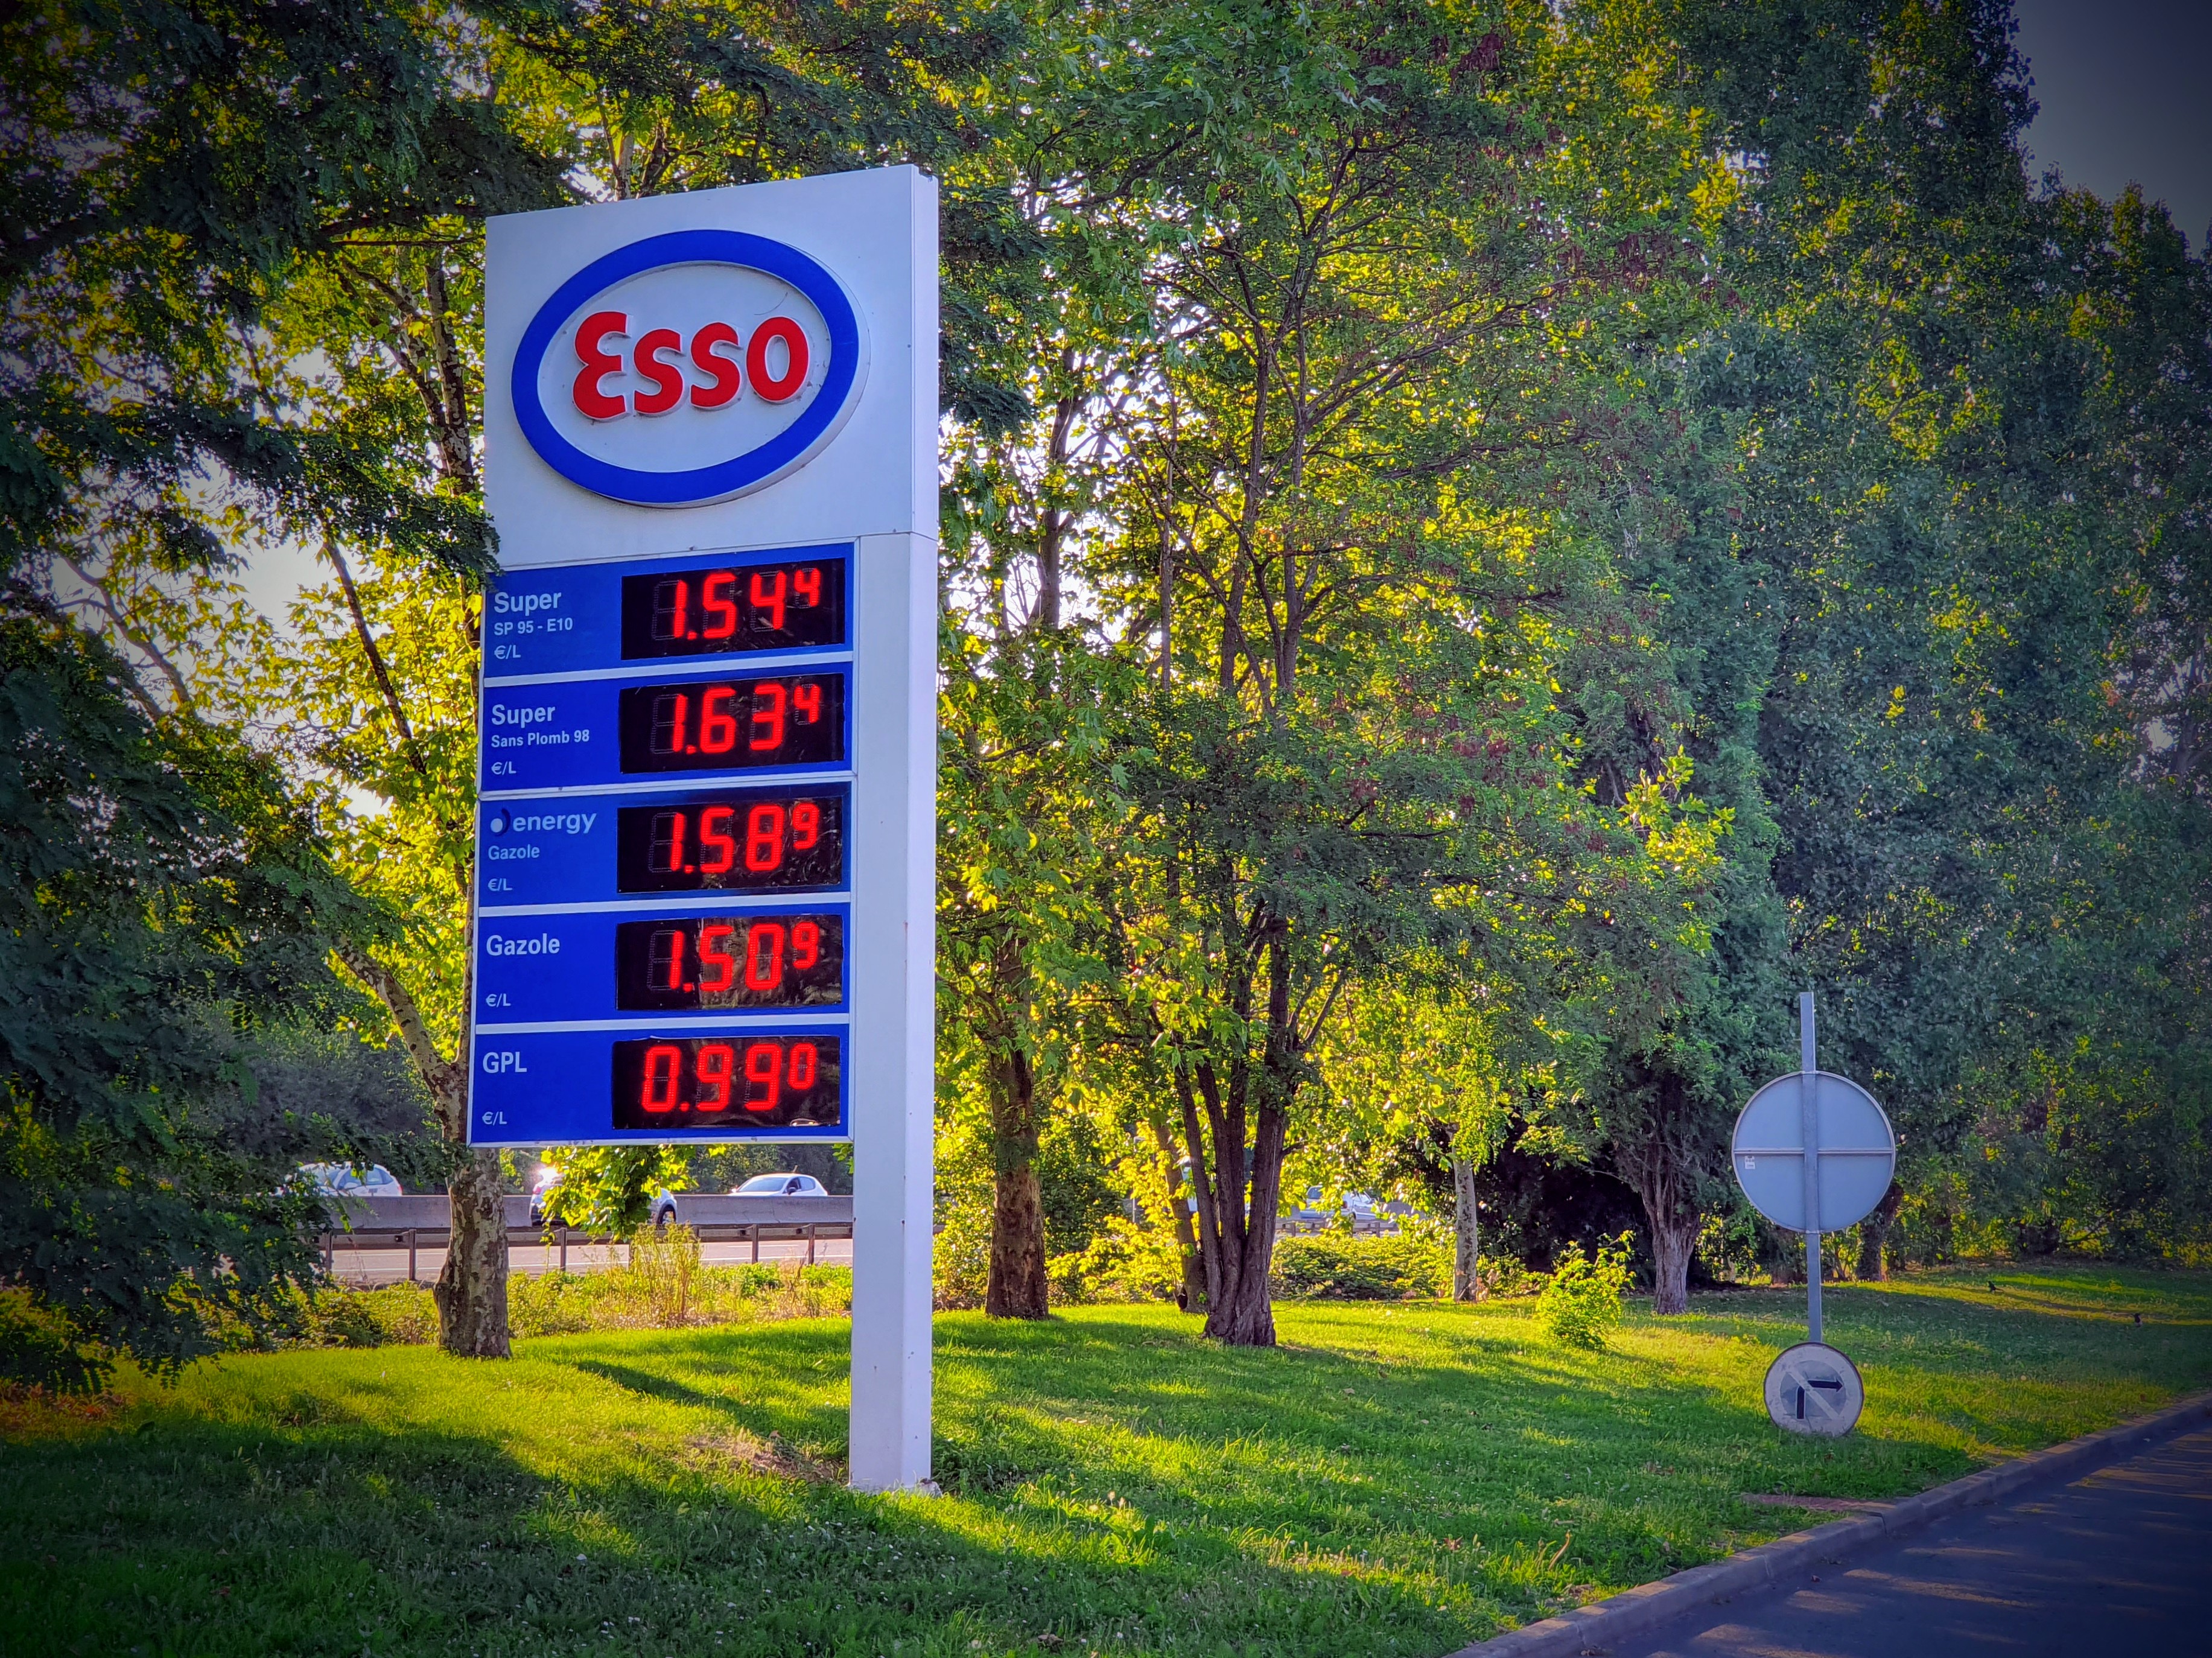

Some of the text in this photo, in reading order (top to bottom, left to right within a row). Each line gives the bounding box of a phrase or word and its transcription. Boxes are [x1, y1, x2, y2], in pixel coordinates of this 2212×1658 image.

[494, 591, 562, 617] Super
[494, 622, 513, 636] SP
[517, 620, 534, 634] 95
[547, 617, 574, 632] E10
[494, 644, 521, 659] €/L
[491, 704, 556, 728] Super
[491, 729, 590, 748] Sans Plomb 98
[491, 761, 517, 775] €/L
[513, 813, 597, 834] energy
[488, 844, 541, 860] Gazole
[488, 878, 513, 892] €/L
[486, 933, 561, 956] Gazole
[485, 993, 512, 1008] €/L
[482, 1051, 527, 1073] GPL
[482, 1111, 507, 1126] €/L
